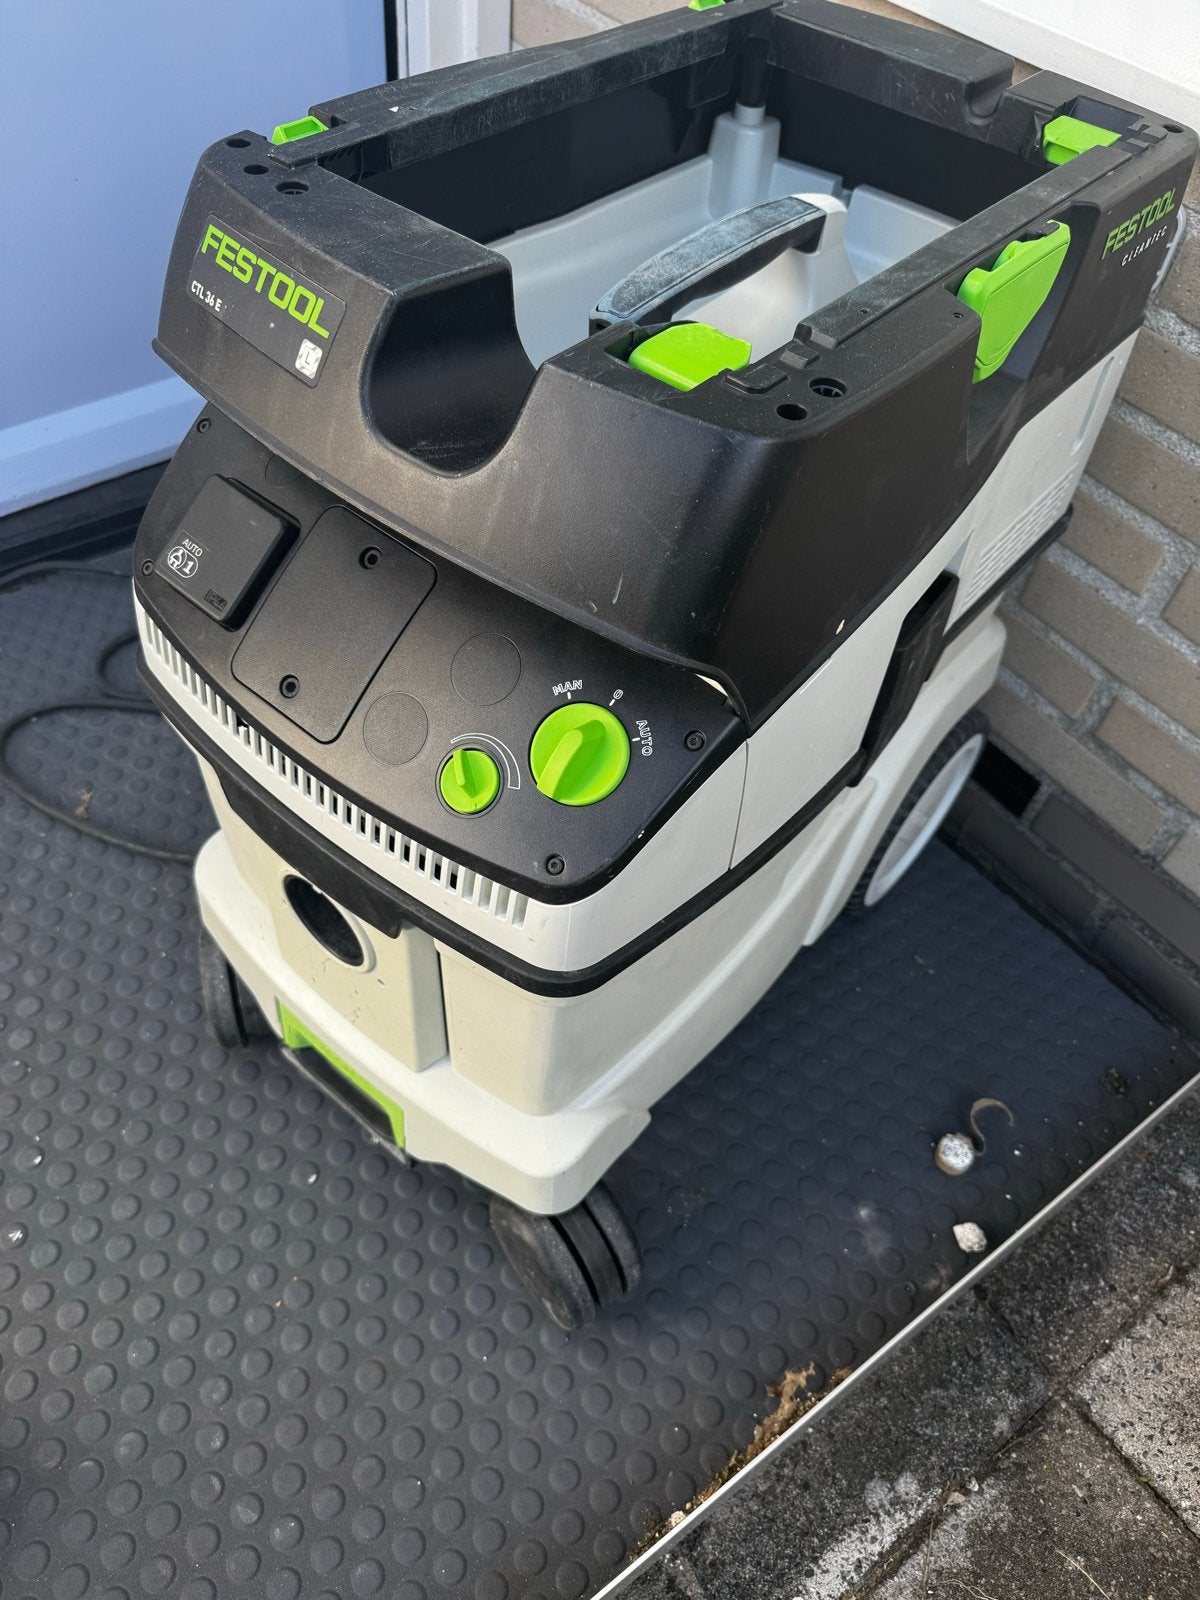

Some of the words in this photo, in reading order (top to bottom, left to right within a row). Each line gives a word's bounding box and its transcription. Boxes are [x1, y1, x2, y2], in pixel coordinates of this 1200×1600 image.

[1101, 188, 1176, 260] FESTOOL
[191, 280, 204, 300] CTL
[204, 291, 215, 307] 36
[214, 298, 222, 312] E
[200, 224, 330, 339] FESTOOL
[182, 538, 203, 557] AUTO
[182, 560, 194, 575] 1
[552, 679, 583, 696] MAN
[635, 719, 653, 757] AUTO
